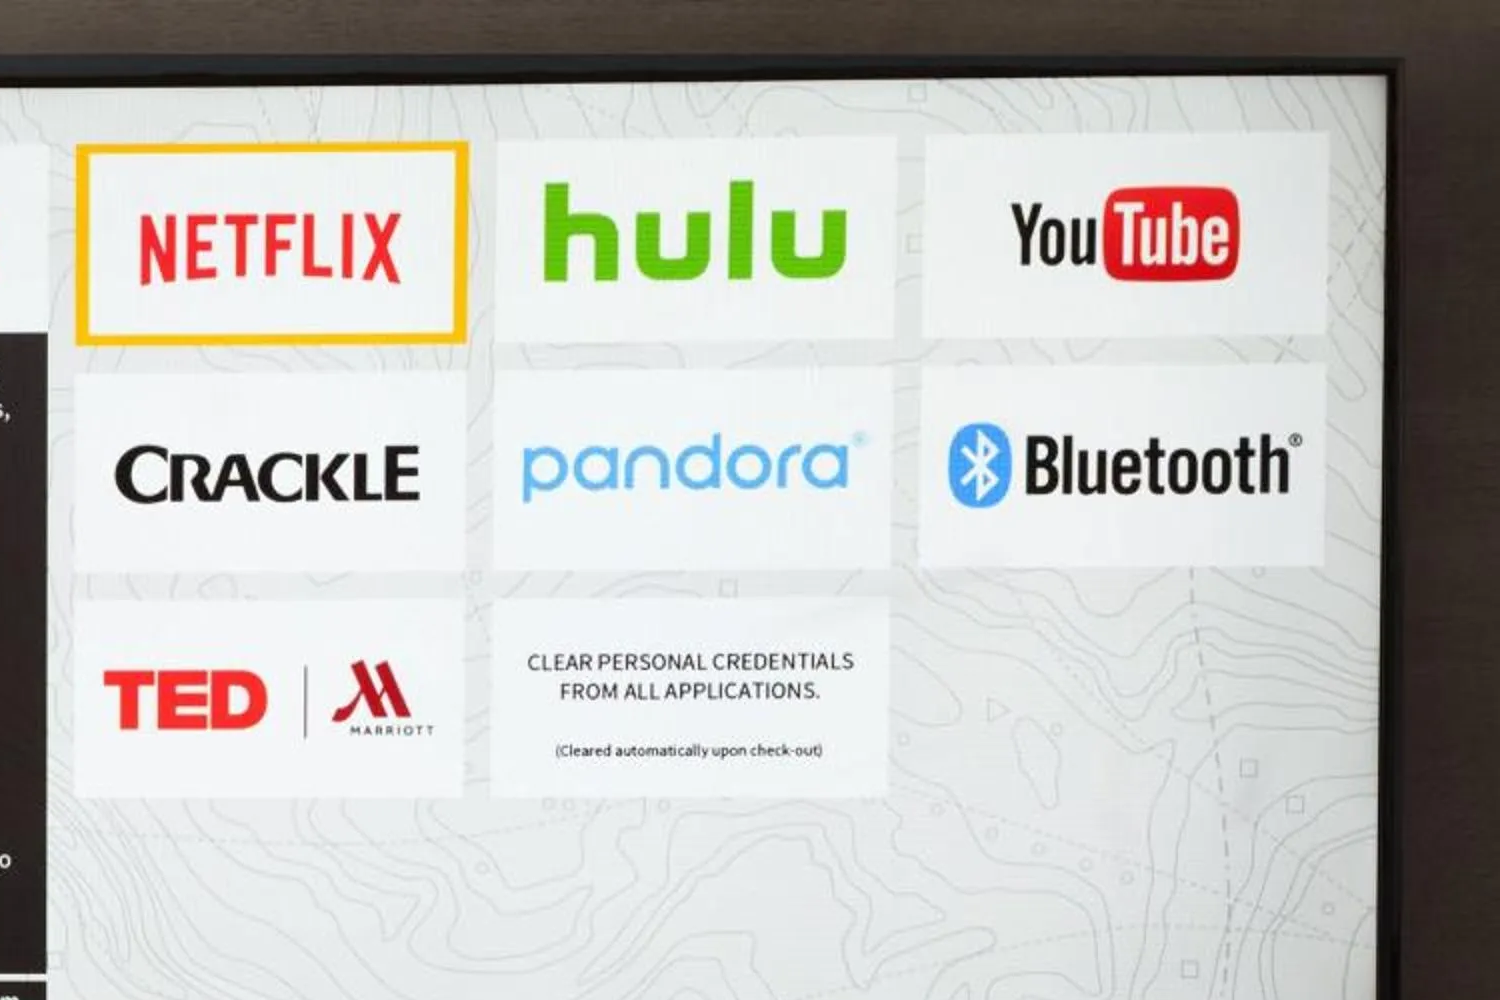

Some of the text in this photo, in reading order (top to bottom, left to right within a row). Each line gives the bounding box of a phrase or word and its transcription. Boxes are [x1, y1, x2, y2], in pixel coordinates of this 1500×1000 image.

[140, 213, 401, 286] NETFLIX
[544, 181, 846, 281] hulu
[1010, 201, 1230, 267] YouTube
[114, 444, 421, 505] CRACKLE
[527, 652, 854, 671] CLEAR PERSONAL CREDENTIALS
[560, 681, 820, 700] FROM ALL APPLICATIONS.
[103, 670, 269, 731] TED
[349, 725, 435, 737] MARRIOTT
[555, 743, 823, 760] (Cleared automatically upon check-out)
